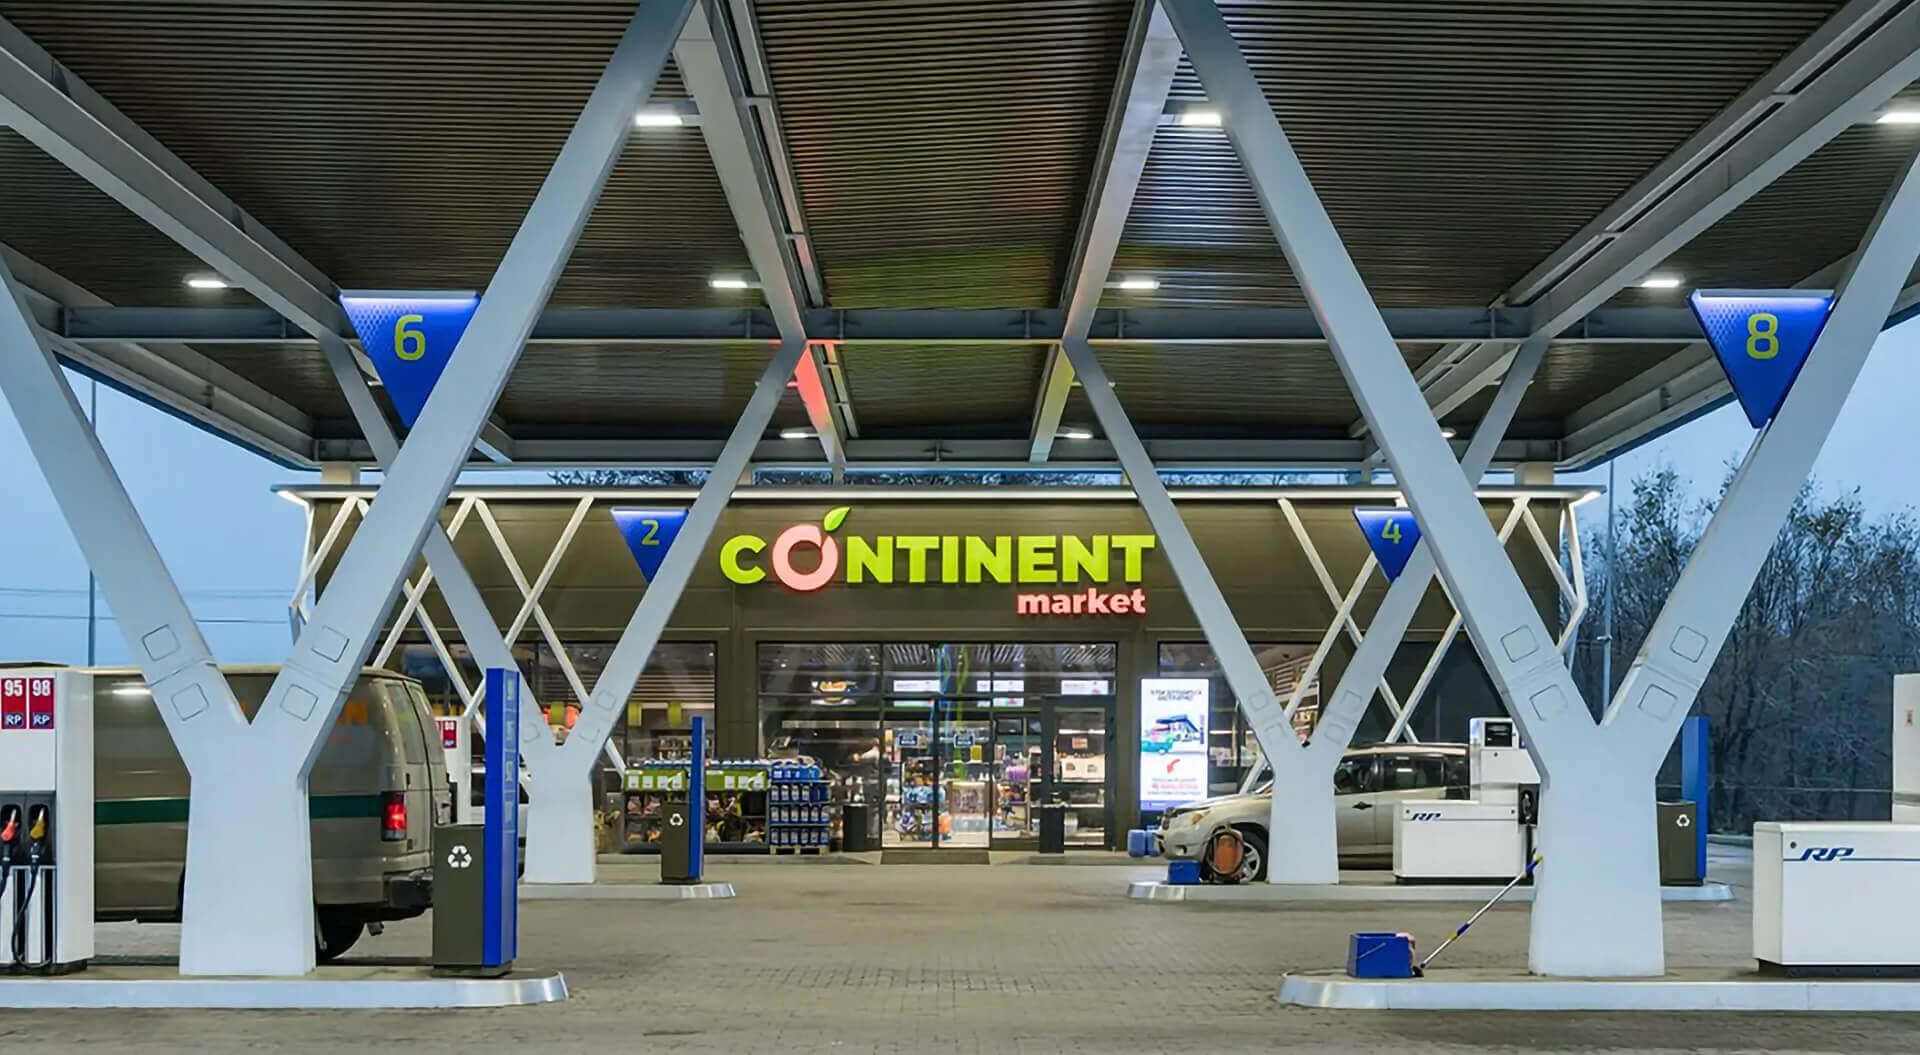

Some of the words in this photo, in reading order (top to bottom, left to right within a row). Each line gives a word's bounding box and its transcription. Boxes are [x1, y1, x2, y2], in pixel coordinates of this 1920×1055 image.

[395, 314, 426, 361] 6
[1746, 312, 1779, 359] 8
[641, 519, 660, 546] 2
[1382, 517, 1402, 545] 4
[719, 523, 1156, 592] CONTINENT
[1016, 587, 1147, 616] market
[4, 679, 23, 697] 95
[32, 679, 51, 697] 98
[5, 714, 22, 726] RP
[33, 714, 50, 726] RP
[1410, 812, 1442, 821] RP
[1799, 847, 1854, 861] RP
